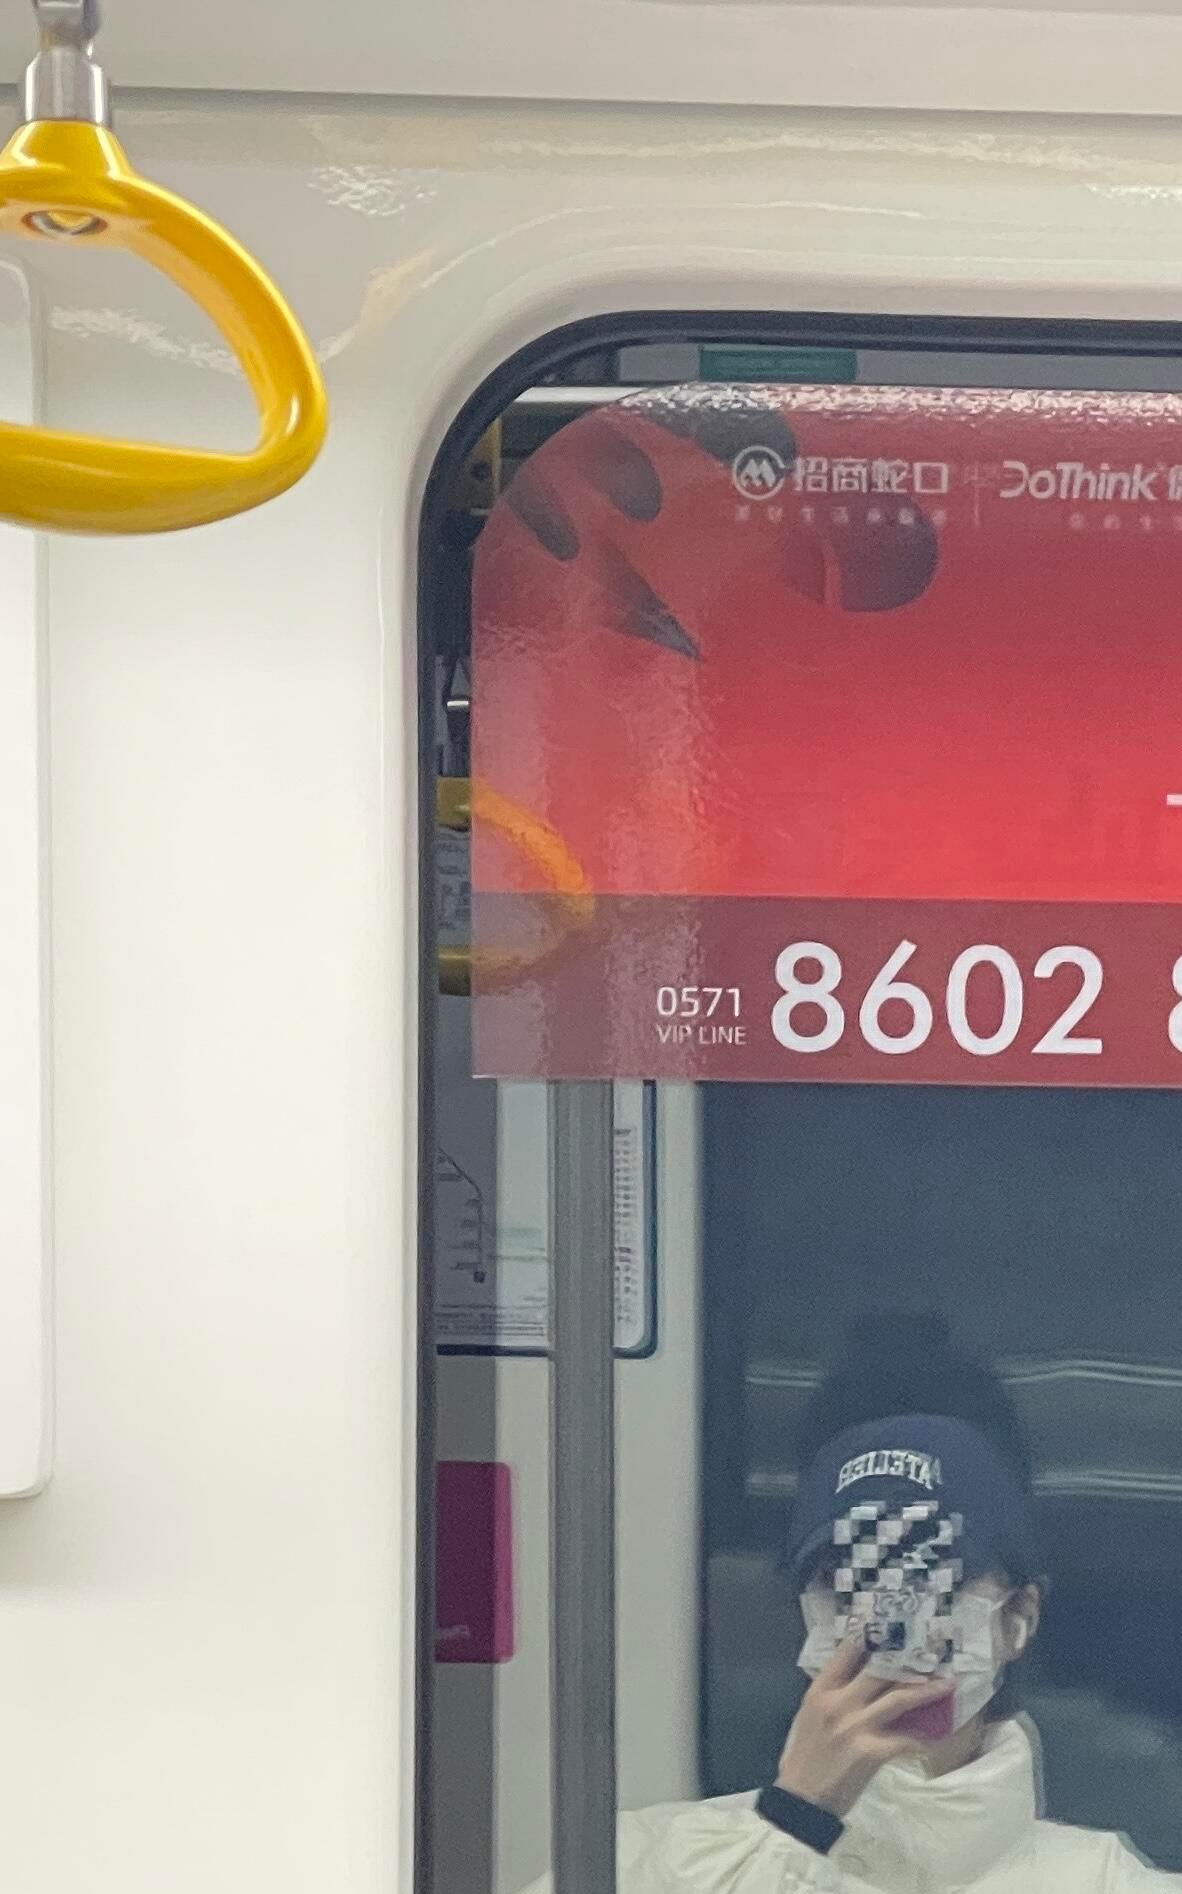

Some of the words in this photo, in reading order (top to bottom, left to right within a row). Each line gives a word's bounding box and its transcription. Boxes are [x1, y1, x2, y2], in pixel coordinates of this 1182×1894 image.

[794, 457, 949, 494] 招商蛇口
[656, 986, 742, 1018] 0571
[771, 940, 1104, 1056] 8602
[656, 1025, 691, 1045] VIP
[700, 1026, 748, 1046] LINE
